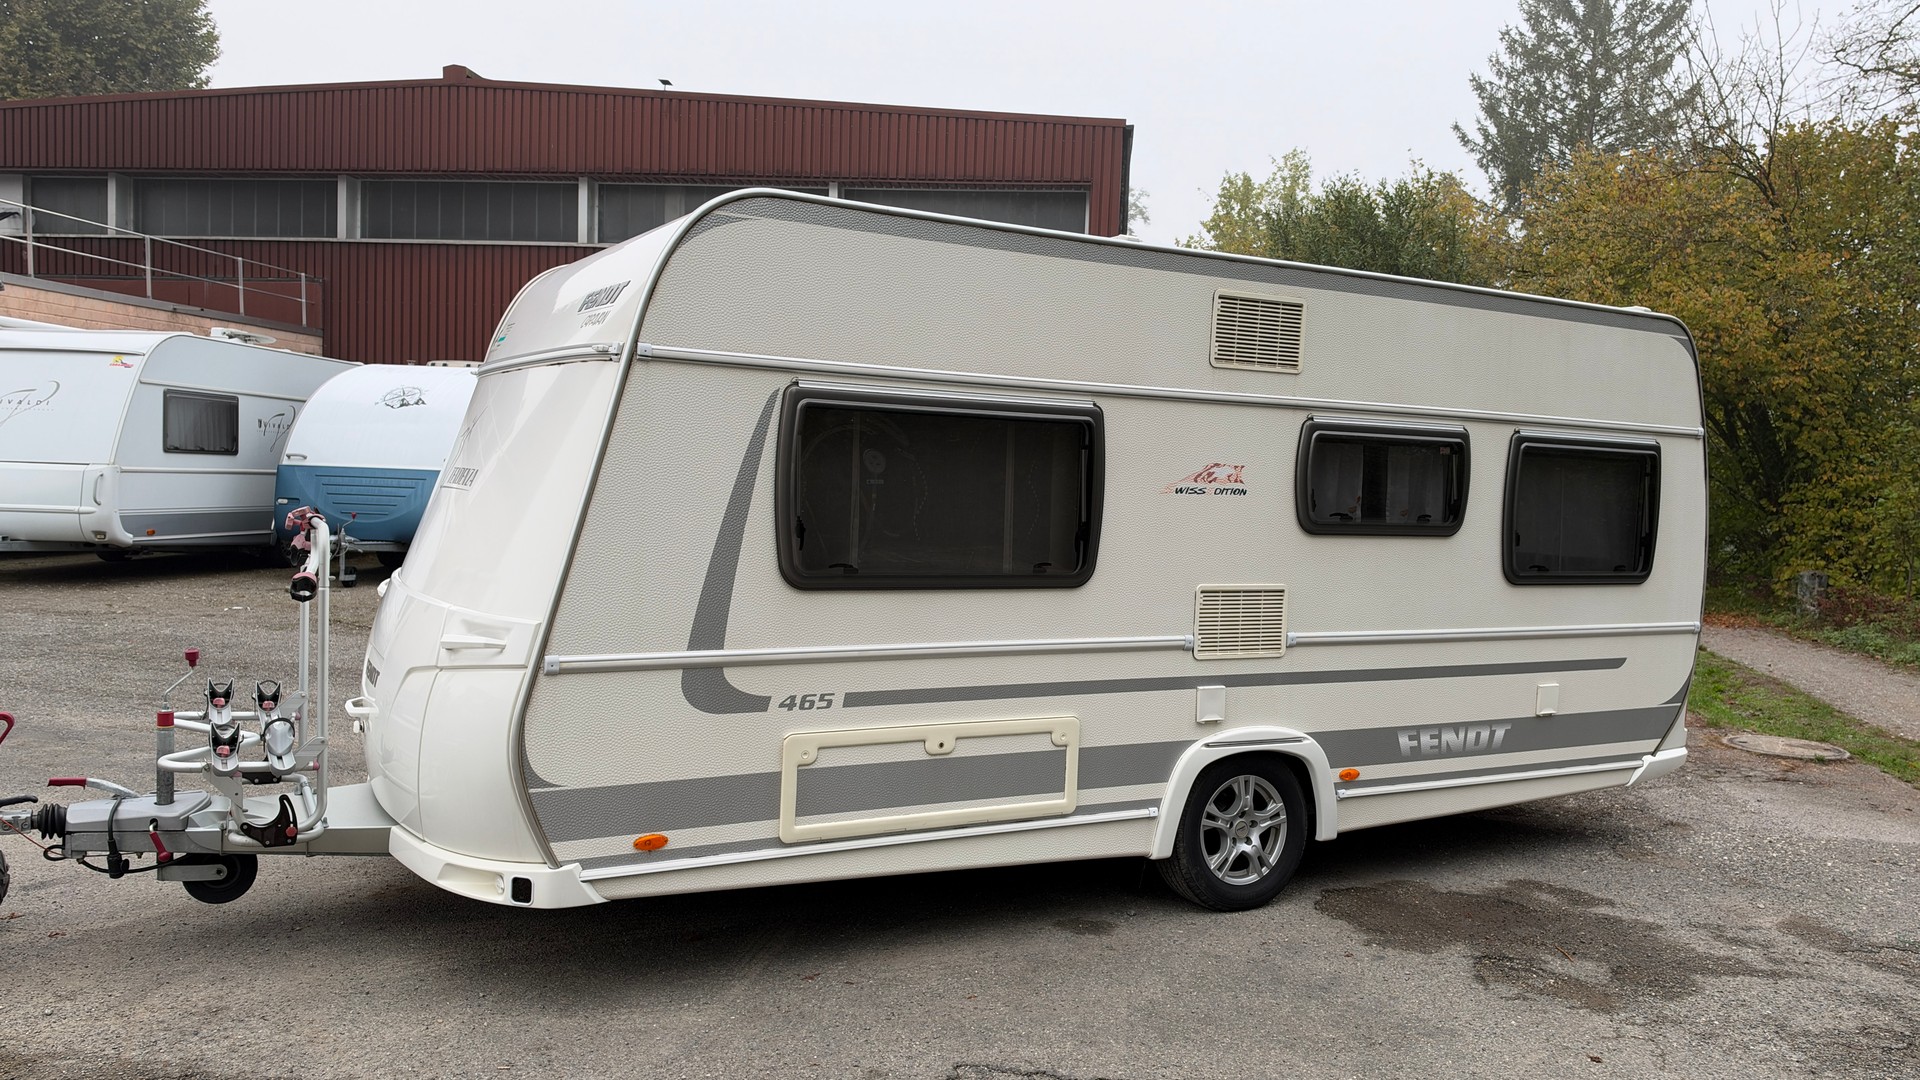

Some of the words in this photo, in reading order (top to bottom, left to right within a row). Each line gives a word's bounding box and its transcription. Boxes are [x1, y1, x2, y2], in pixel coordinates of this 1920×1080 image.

[577, 280, 631, 312] FENDT
[1207, 487, 1247, 496] DITION
[778, 693, 835, 711] 465
[1397, 722, 1512, 757] FENDT
